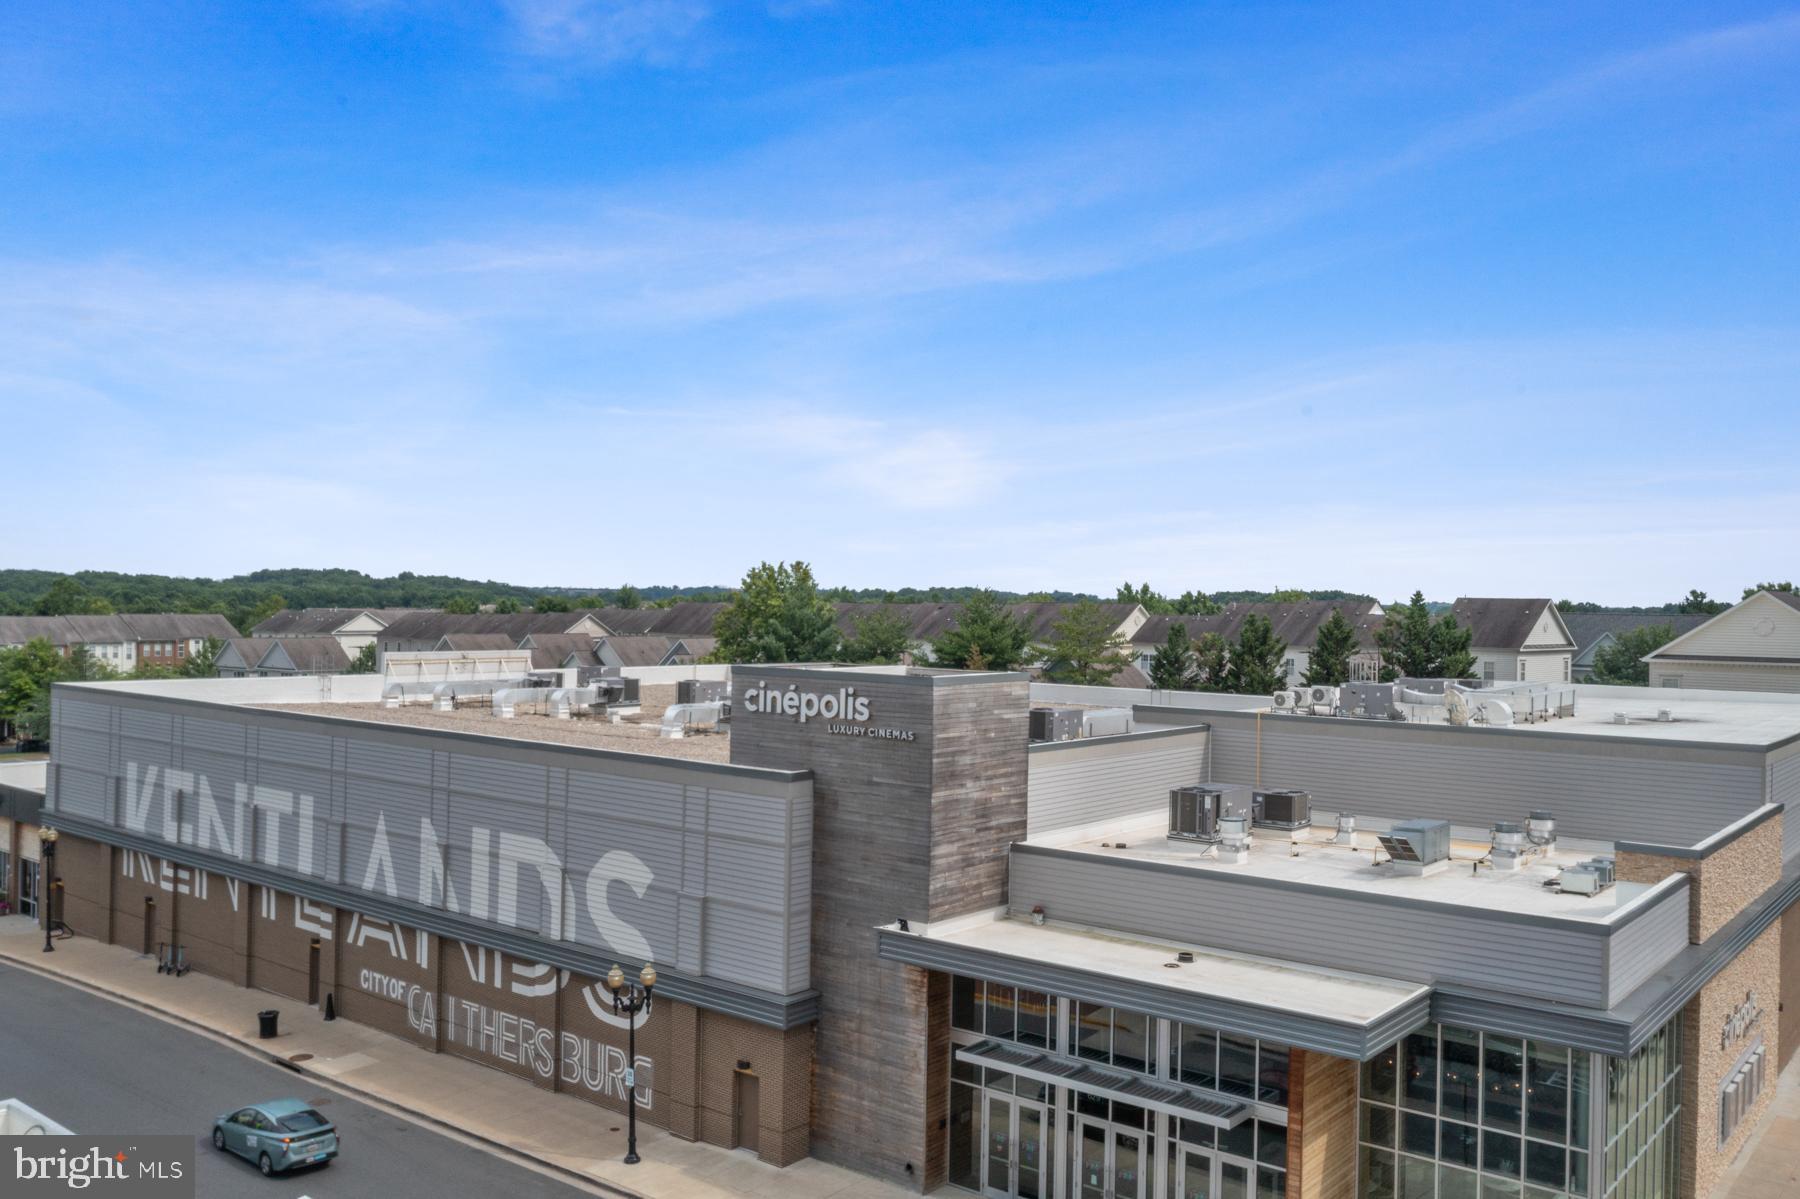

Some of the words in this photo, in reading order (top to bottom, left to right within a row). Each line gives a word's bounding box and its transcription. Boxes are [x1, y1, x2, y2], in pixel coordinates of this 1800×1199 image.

[744, 680, 870, 723] cinépolis
[827, 723, 866, 736] LUXURY
[867, 727, 914, 741] CINEMAS
